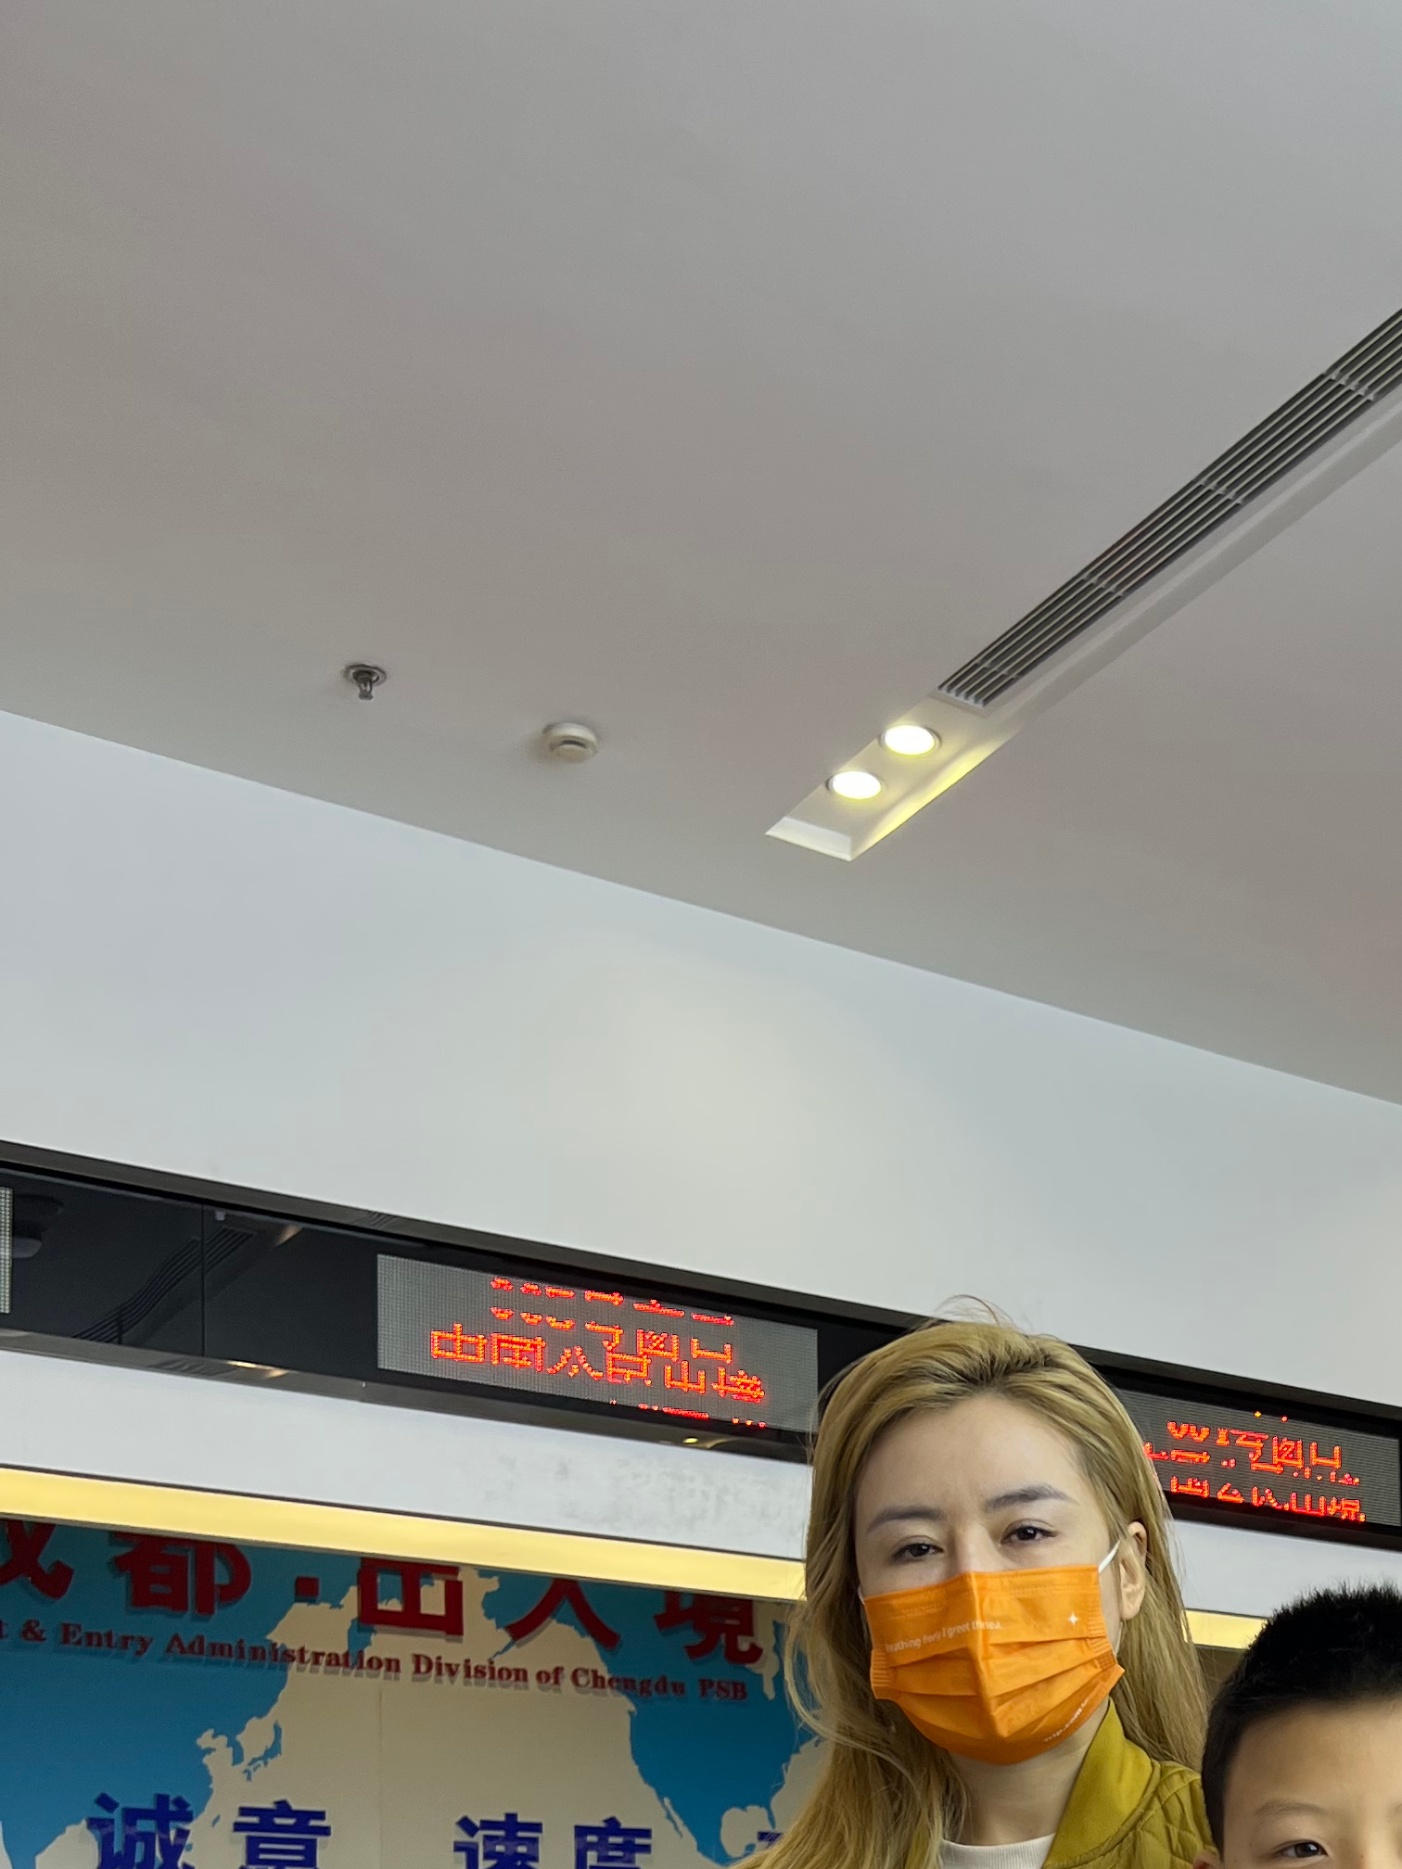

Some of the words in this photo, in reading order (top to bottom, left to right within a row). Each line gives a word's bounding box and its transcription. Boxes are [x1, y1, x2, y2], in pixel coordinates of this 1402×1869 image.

[20, 1619, 47, 1642] &
[60, 1622, 154, 1657] Entry
[165, 1631, 401, 1673] Administration
[412, 1653, 528, 1684] Division
[536, 1665, 564, 1687] of
[571, 1667, 687, 1697] Chengdu
[699, 1677, 748, 1700] PSB
